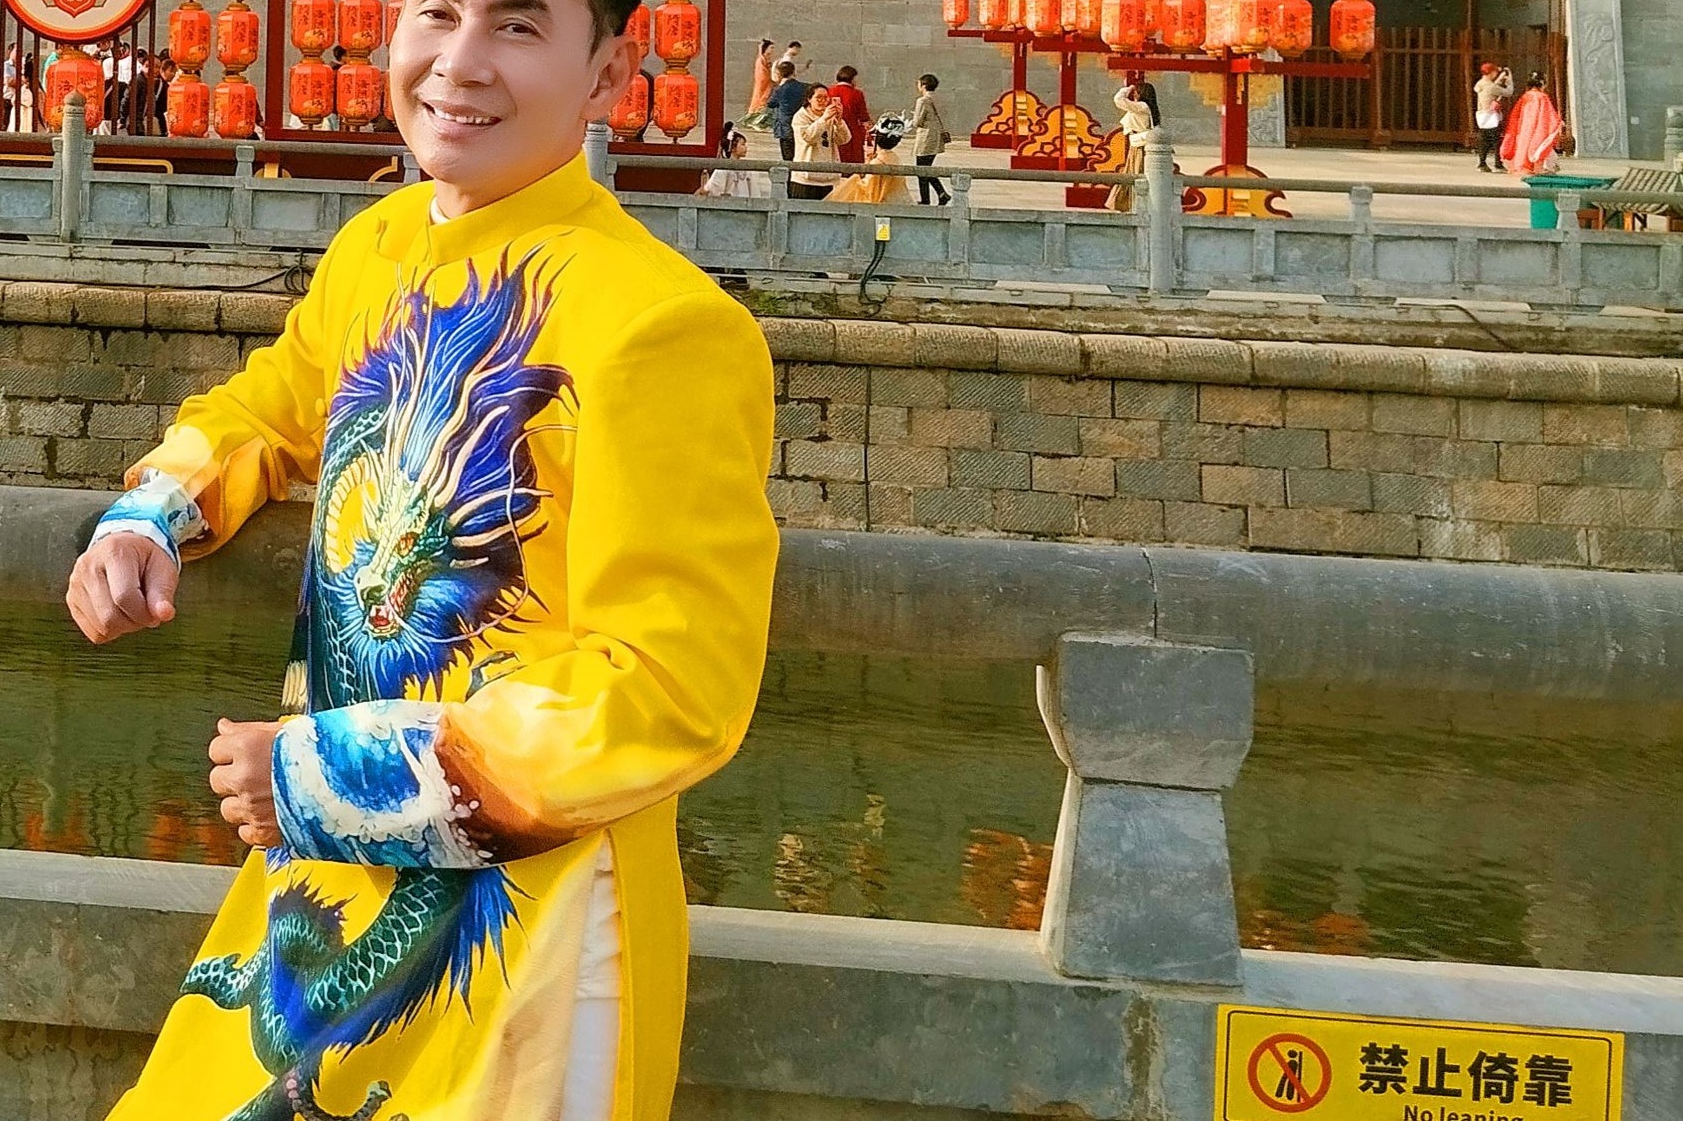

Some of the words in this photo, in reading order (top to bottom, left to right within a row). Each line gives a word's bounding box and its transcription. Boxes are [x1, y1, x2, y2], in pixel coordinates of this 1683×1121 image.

[1358, 1042, 1573, 1107] 禁止倚靠
[1404, 1105, 1433, 1121] No
[1440, 1106, 1524, 1121] leani
